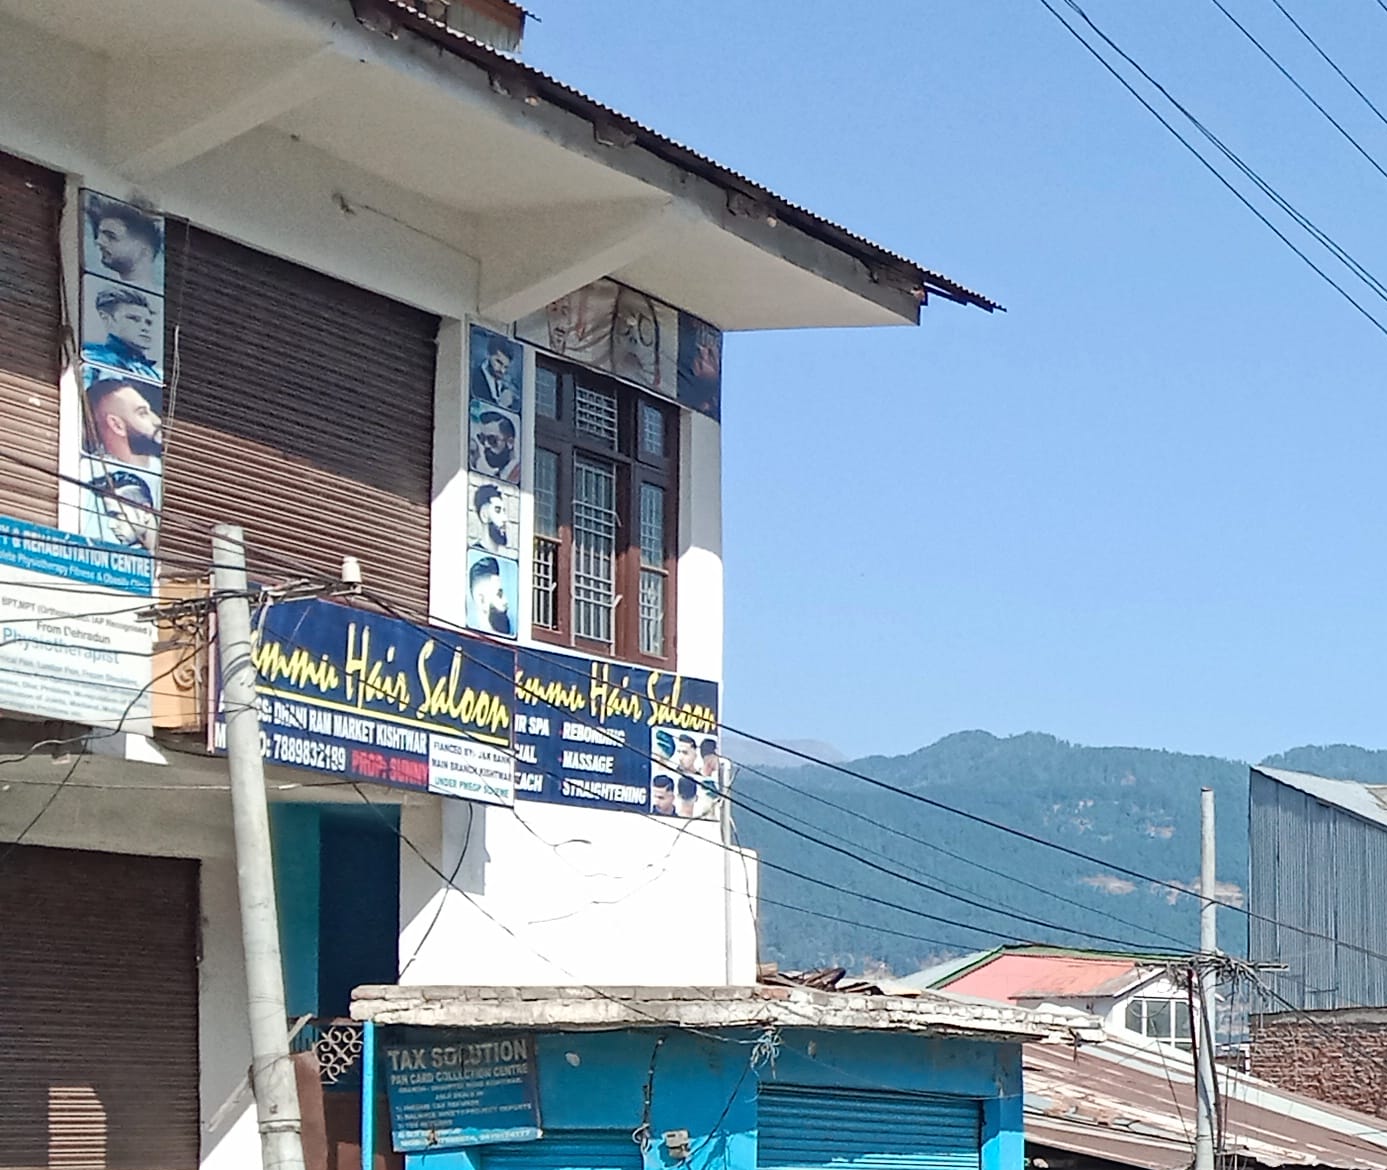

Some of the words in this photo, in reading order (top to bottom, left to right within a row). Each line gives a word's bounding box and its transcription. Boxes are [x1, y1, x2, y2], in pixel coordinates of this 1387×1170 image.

[111, 552, 151, 577] CENTRE
[37, 621, 61, 634] From
[346, 623, 410, 711] Hair
[416, 638, 509, 733] Saloon
[589, 661, 642, 724] Hair
[646, 671, 716, 734] Saloon
[308, 708, 333, 736] RAM
[333, 714, 376, 745] MARKET
[376, 723, 428, 754] KISHTWAR
[528, 716, 550, 736] SPA
[562, 750, 614, 775] MASSAGE
[562, 778, 647, 804] STRAIGHTENING
[387, 1048, 427, 1071] TAX
[431, 1039, 528, 1069] SOLUTION
[493, 1062, 529, 1078] CENTRE
